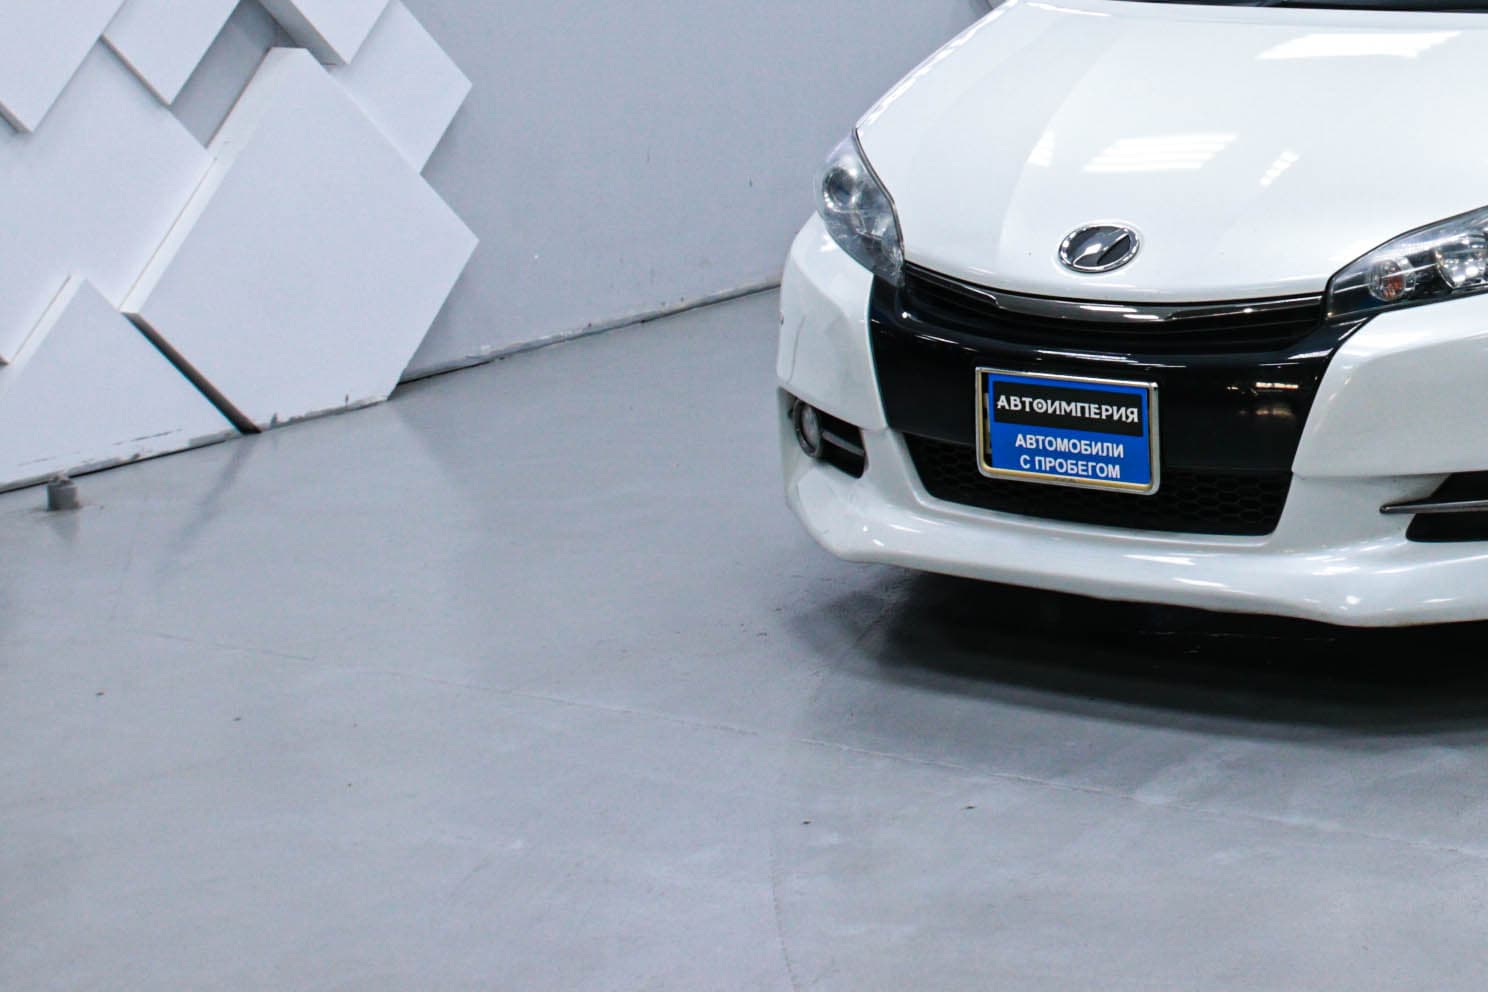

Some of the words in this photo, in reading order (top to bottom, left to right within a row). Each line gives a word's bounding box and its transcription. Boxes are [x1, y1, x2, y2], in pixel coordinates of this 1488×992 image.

[997, 394, 1139, 423] АВТОИМПЕРИЯ
[1015, 433, 1124, 459] АВТОМОБИЛИ
[1019, 454, 1031, 469] С
[1035, 456, 1121, 479] ПРОБЕГОМ
